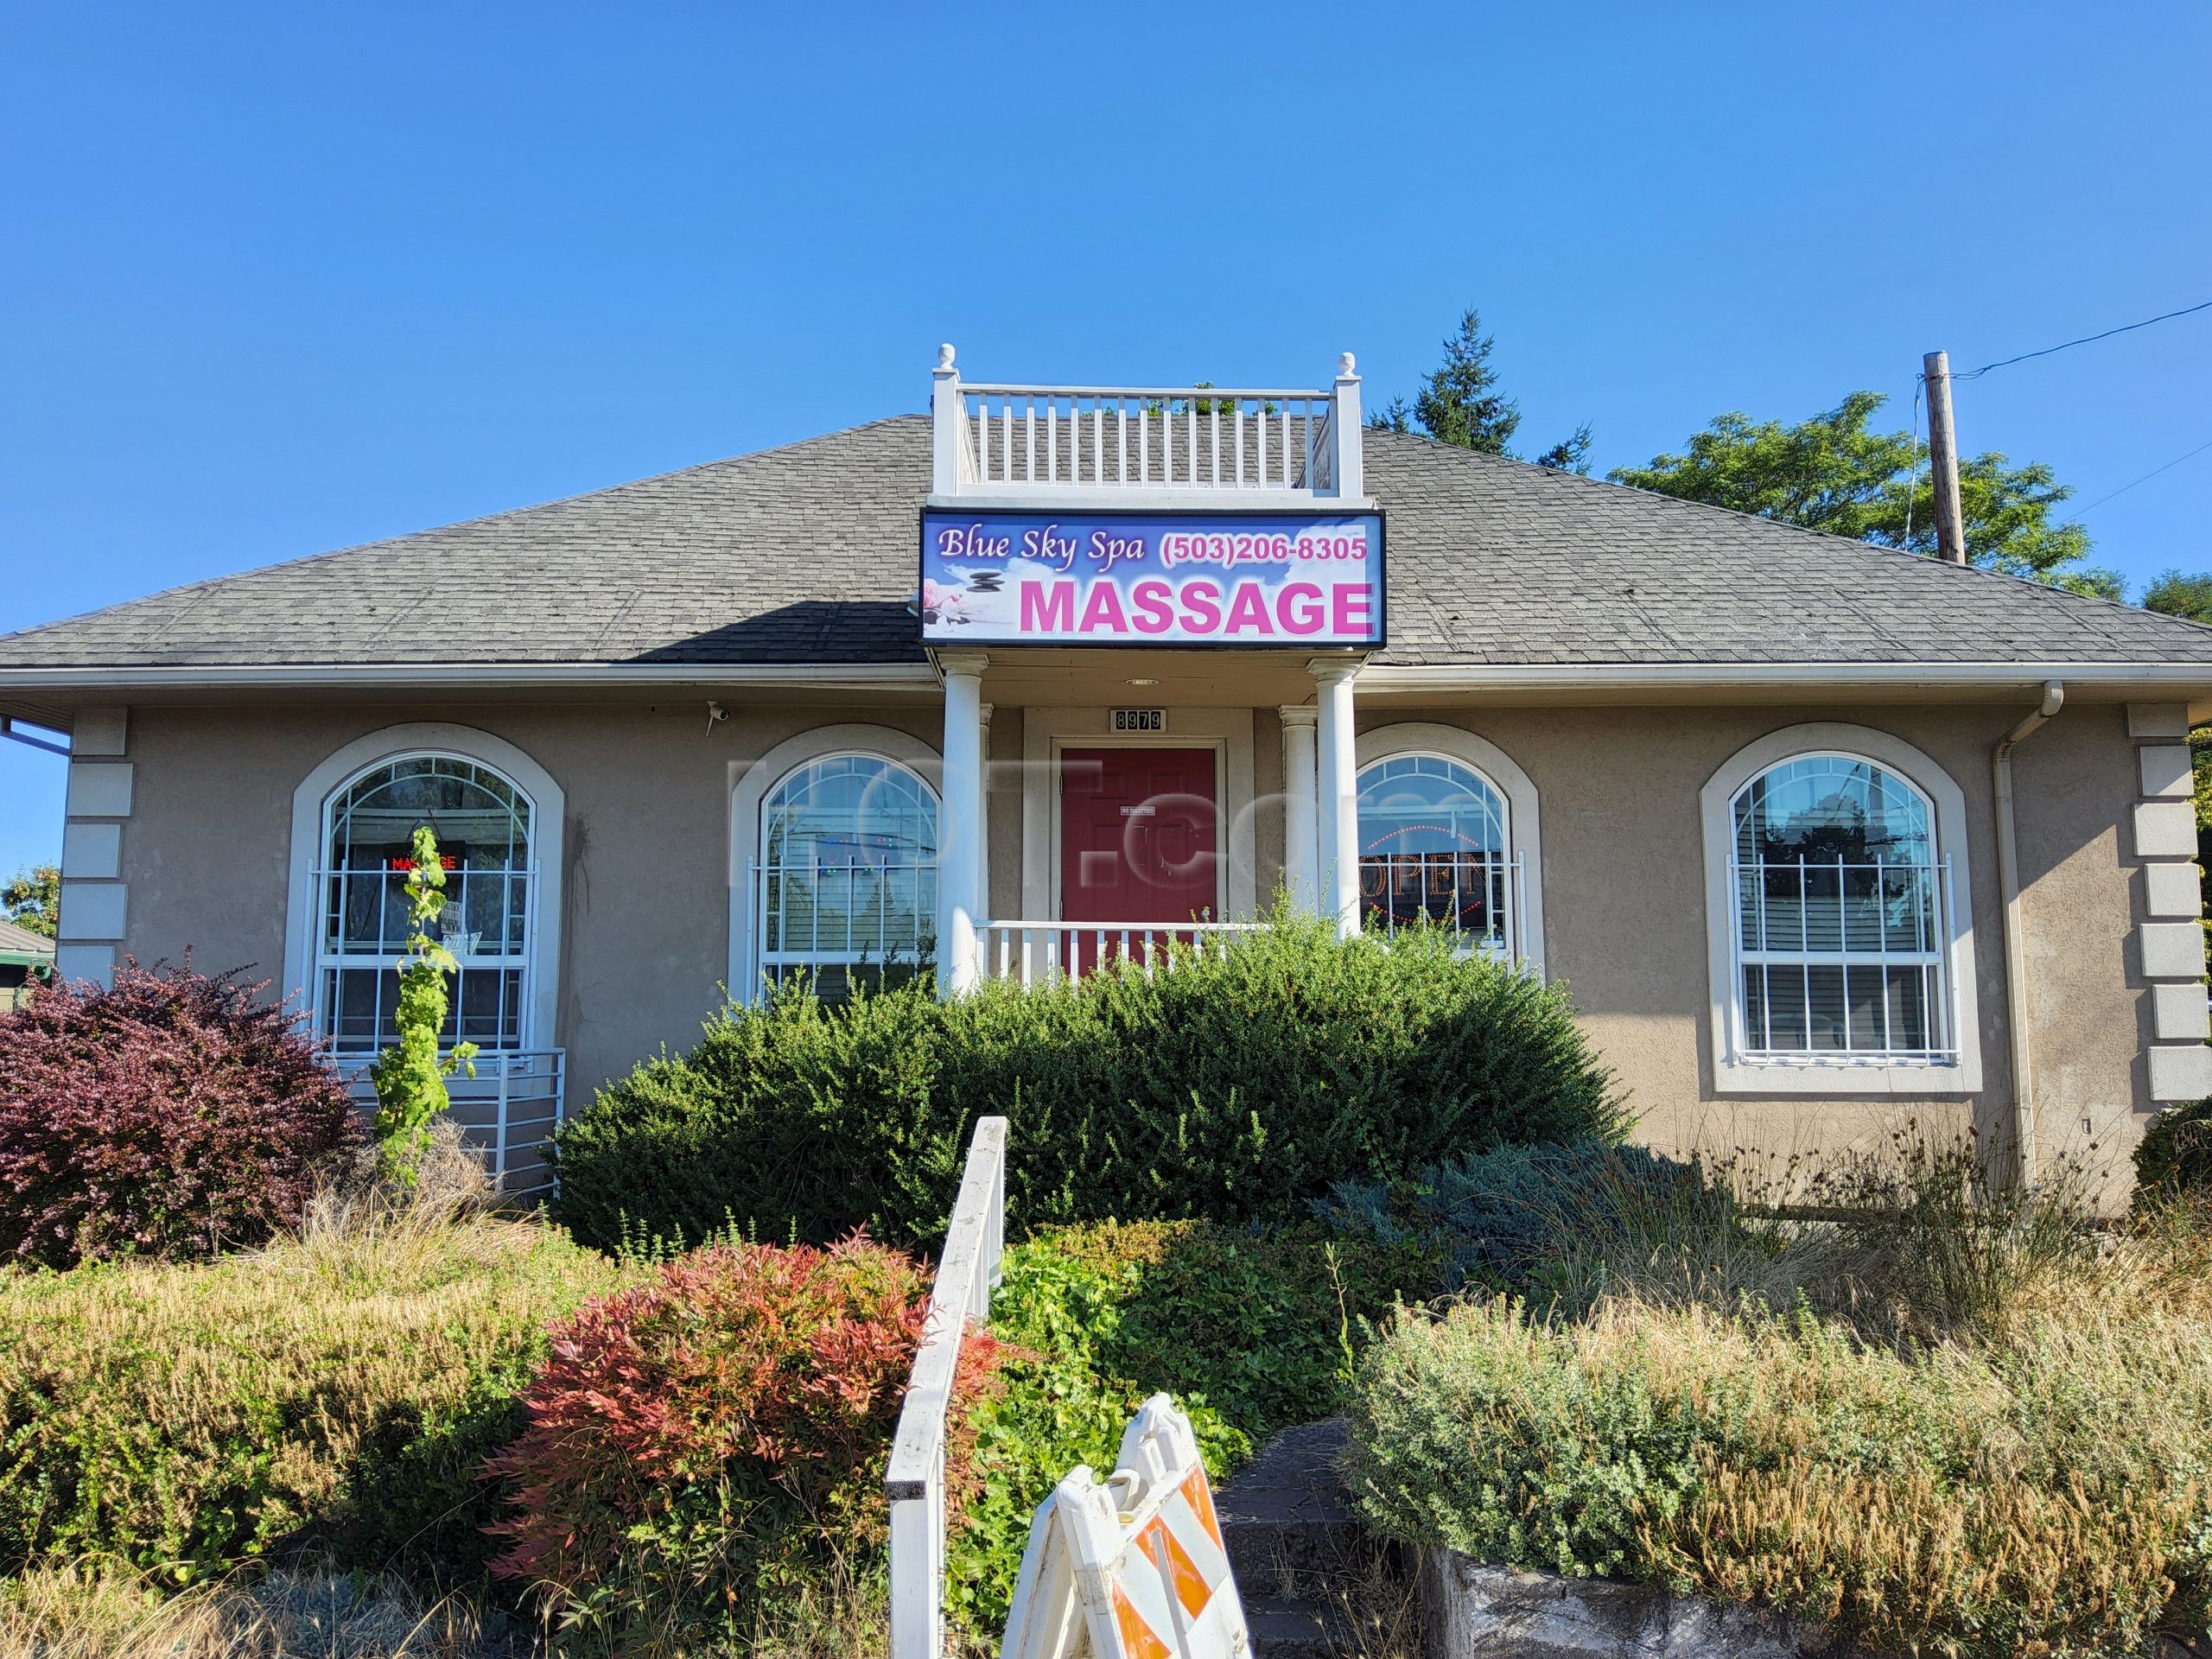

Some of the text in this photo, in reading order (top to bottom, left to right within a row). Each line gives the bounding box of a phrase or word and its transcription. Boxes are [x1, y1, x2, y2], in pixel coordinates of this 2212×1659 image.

[938, 524, 1368, 573] Blue Sky Spa (503)206-8305
[1020, 580, 1374, 635] MASSAGE
[1116, 713, 1161, 728] 8979
[1359, 854, 1486, 897] OPEN
